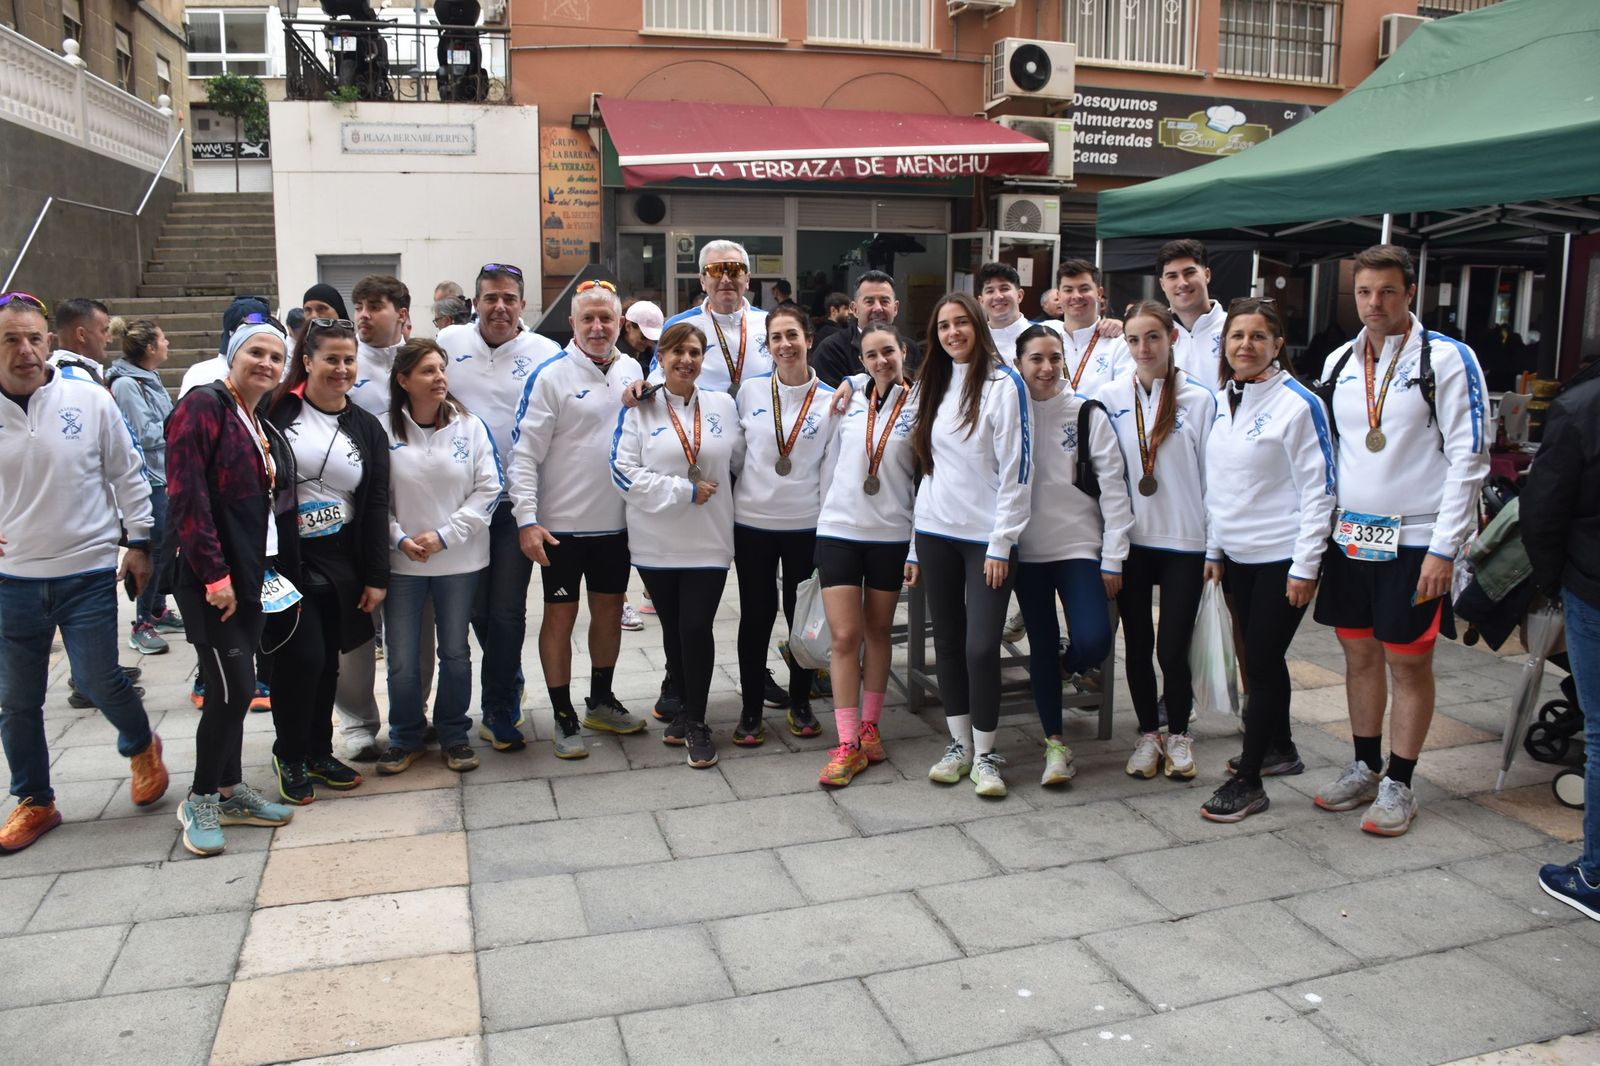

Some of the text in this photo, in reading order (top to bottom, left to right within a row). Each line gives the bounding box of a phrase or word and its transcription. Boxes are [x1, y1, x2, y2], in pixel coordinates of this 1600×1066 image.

[1073, 93, 1158, 112] Desayunos
[1072, 111, 1154, 130] Almuerzos
[363, 133, 391, 143] PLAZA
[1073, 131, 1153, 148] Meriendas
[561, 162, 596, 171] TERRAZA
[692, 155, 990, 178] LA TERRAZA DE MENCHU
[1073, 150, 1118, 165] Cenas
[306, 507, 341, 528] 3486
[1354, 525, 1395, 545] 3322
